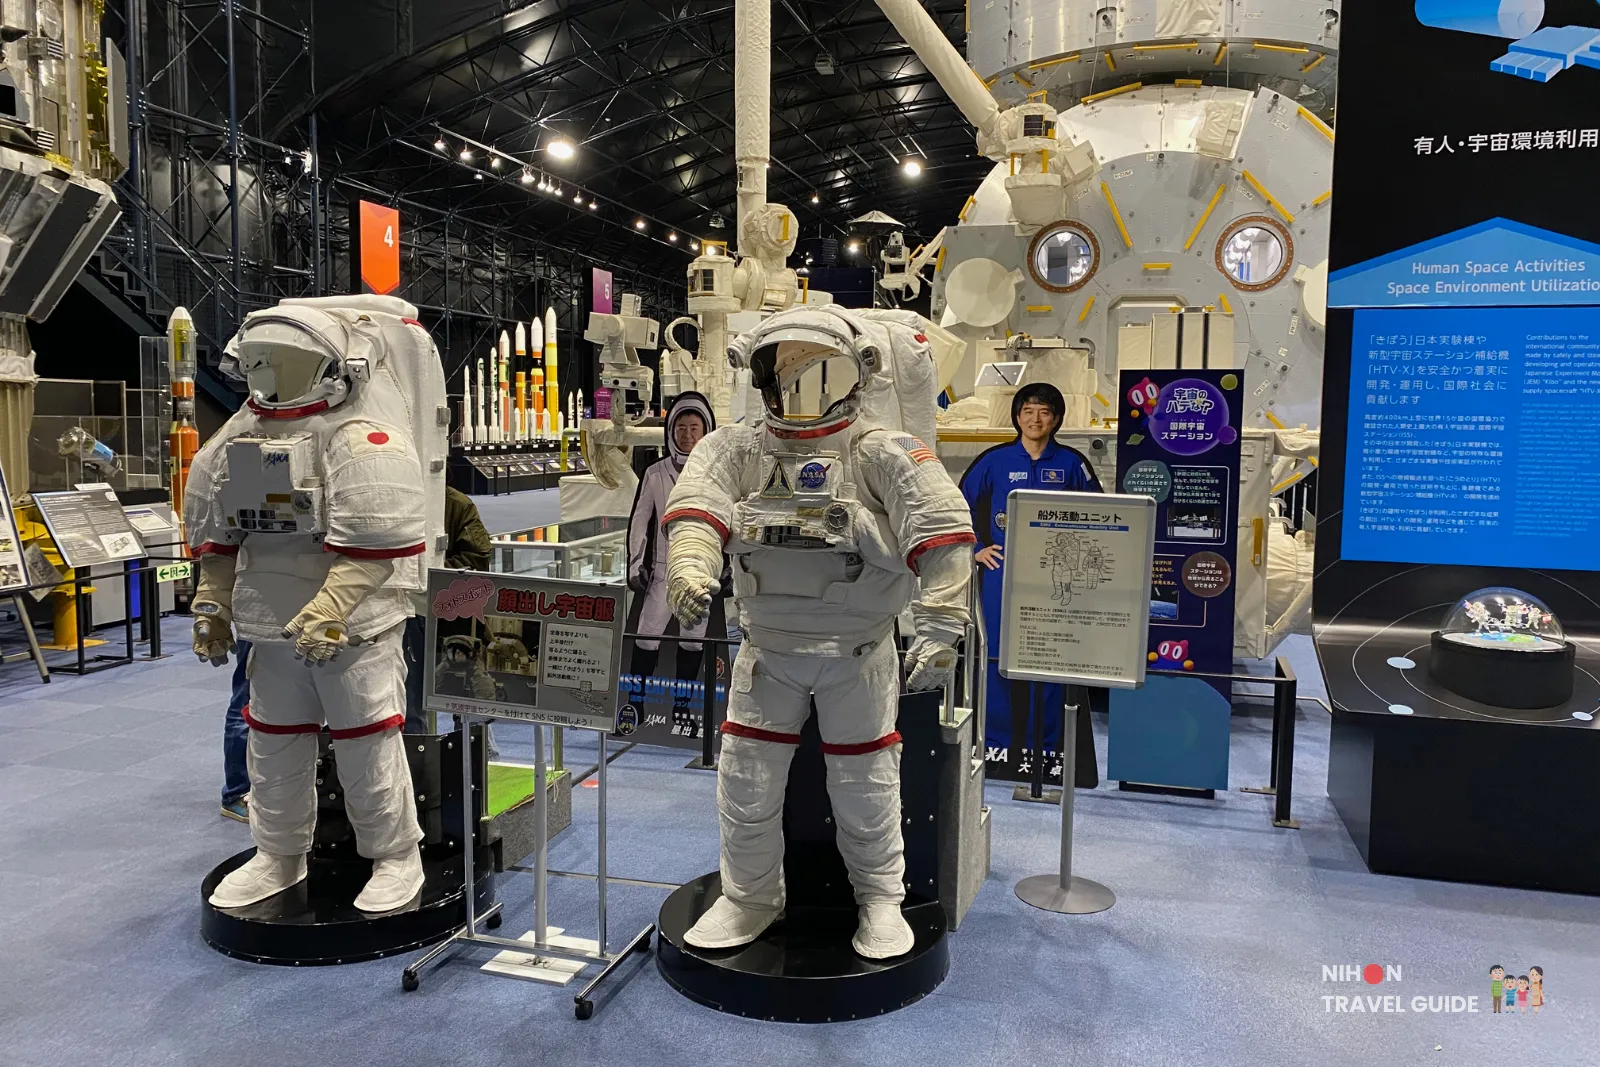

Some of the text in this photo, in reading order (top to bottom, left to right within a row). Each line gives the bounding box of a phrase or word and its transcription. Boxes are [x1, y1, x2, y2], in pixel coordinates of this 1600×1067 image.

[1413, 129, 1599, 155] 有人・宇宙環境利用
[383, 225, 394, 248] 4
[1412, 258, 1586, 276] Human Space Activities
[604, 283, 610, 300] 5
[1387, 281, 1430, 297] Space
[1435, 279, 1526, 294] Environment
[1369, 334, 1487, 346] 「きぼう」日本実験棟や
[1368, 350, 1510, 361] 新型宇宙ステーション補給機
[1368, 364, 1509, 376] 「HTV-X」を安全かつ着実に
[1366, 379, 1508, 391] 開発・運用し、国際社会に
[1174, 388, 1208, 400] 宇宙の
[1366, 394, 1421, 405] 貢献します
[1169, 422, 1205, 431] 国際宇宙
[1161, 432, 1213, 440] ステーション
[802, 471, 825, 479] NASA
[1037, 510, 1122, 524] 船外活動ユニット
[434, 581, 493, 615] フォトスポット
[496, 588, 616, 622] 顔出し宇宙服
[549, 638, 574, 646] 上半身だけ
[618, 674, 642, 692] ISS
[645, 675, 725, 702] EXPEDITIN
[532, 712, 546, 721] SNS
[644, 714, 666, 727] JAXA
[674, 712, 703, 721] 宇宙飛行
